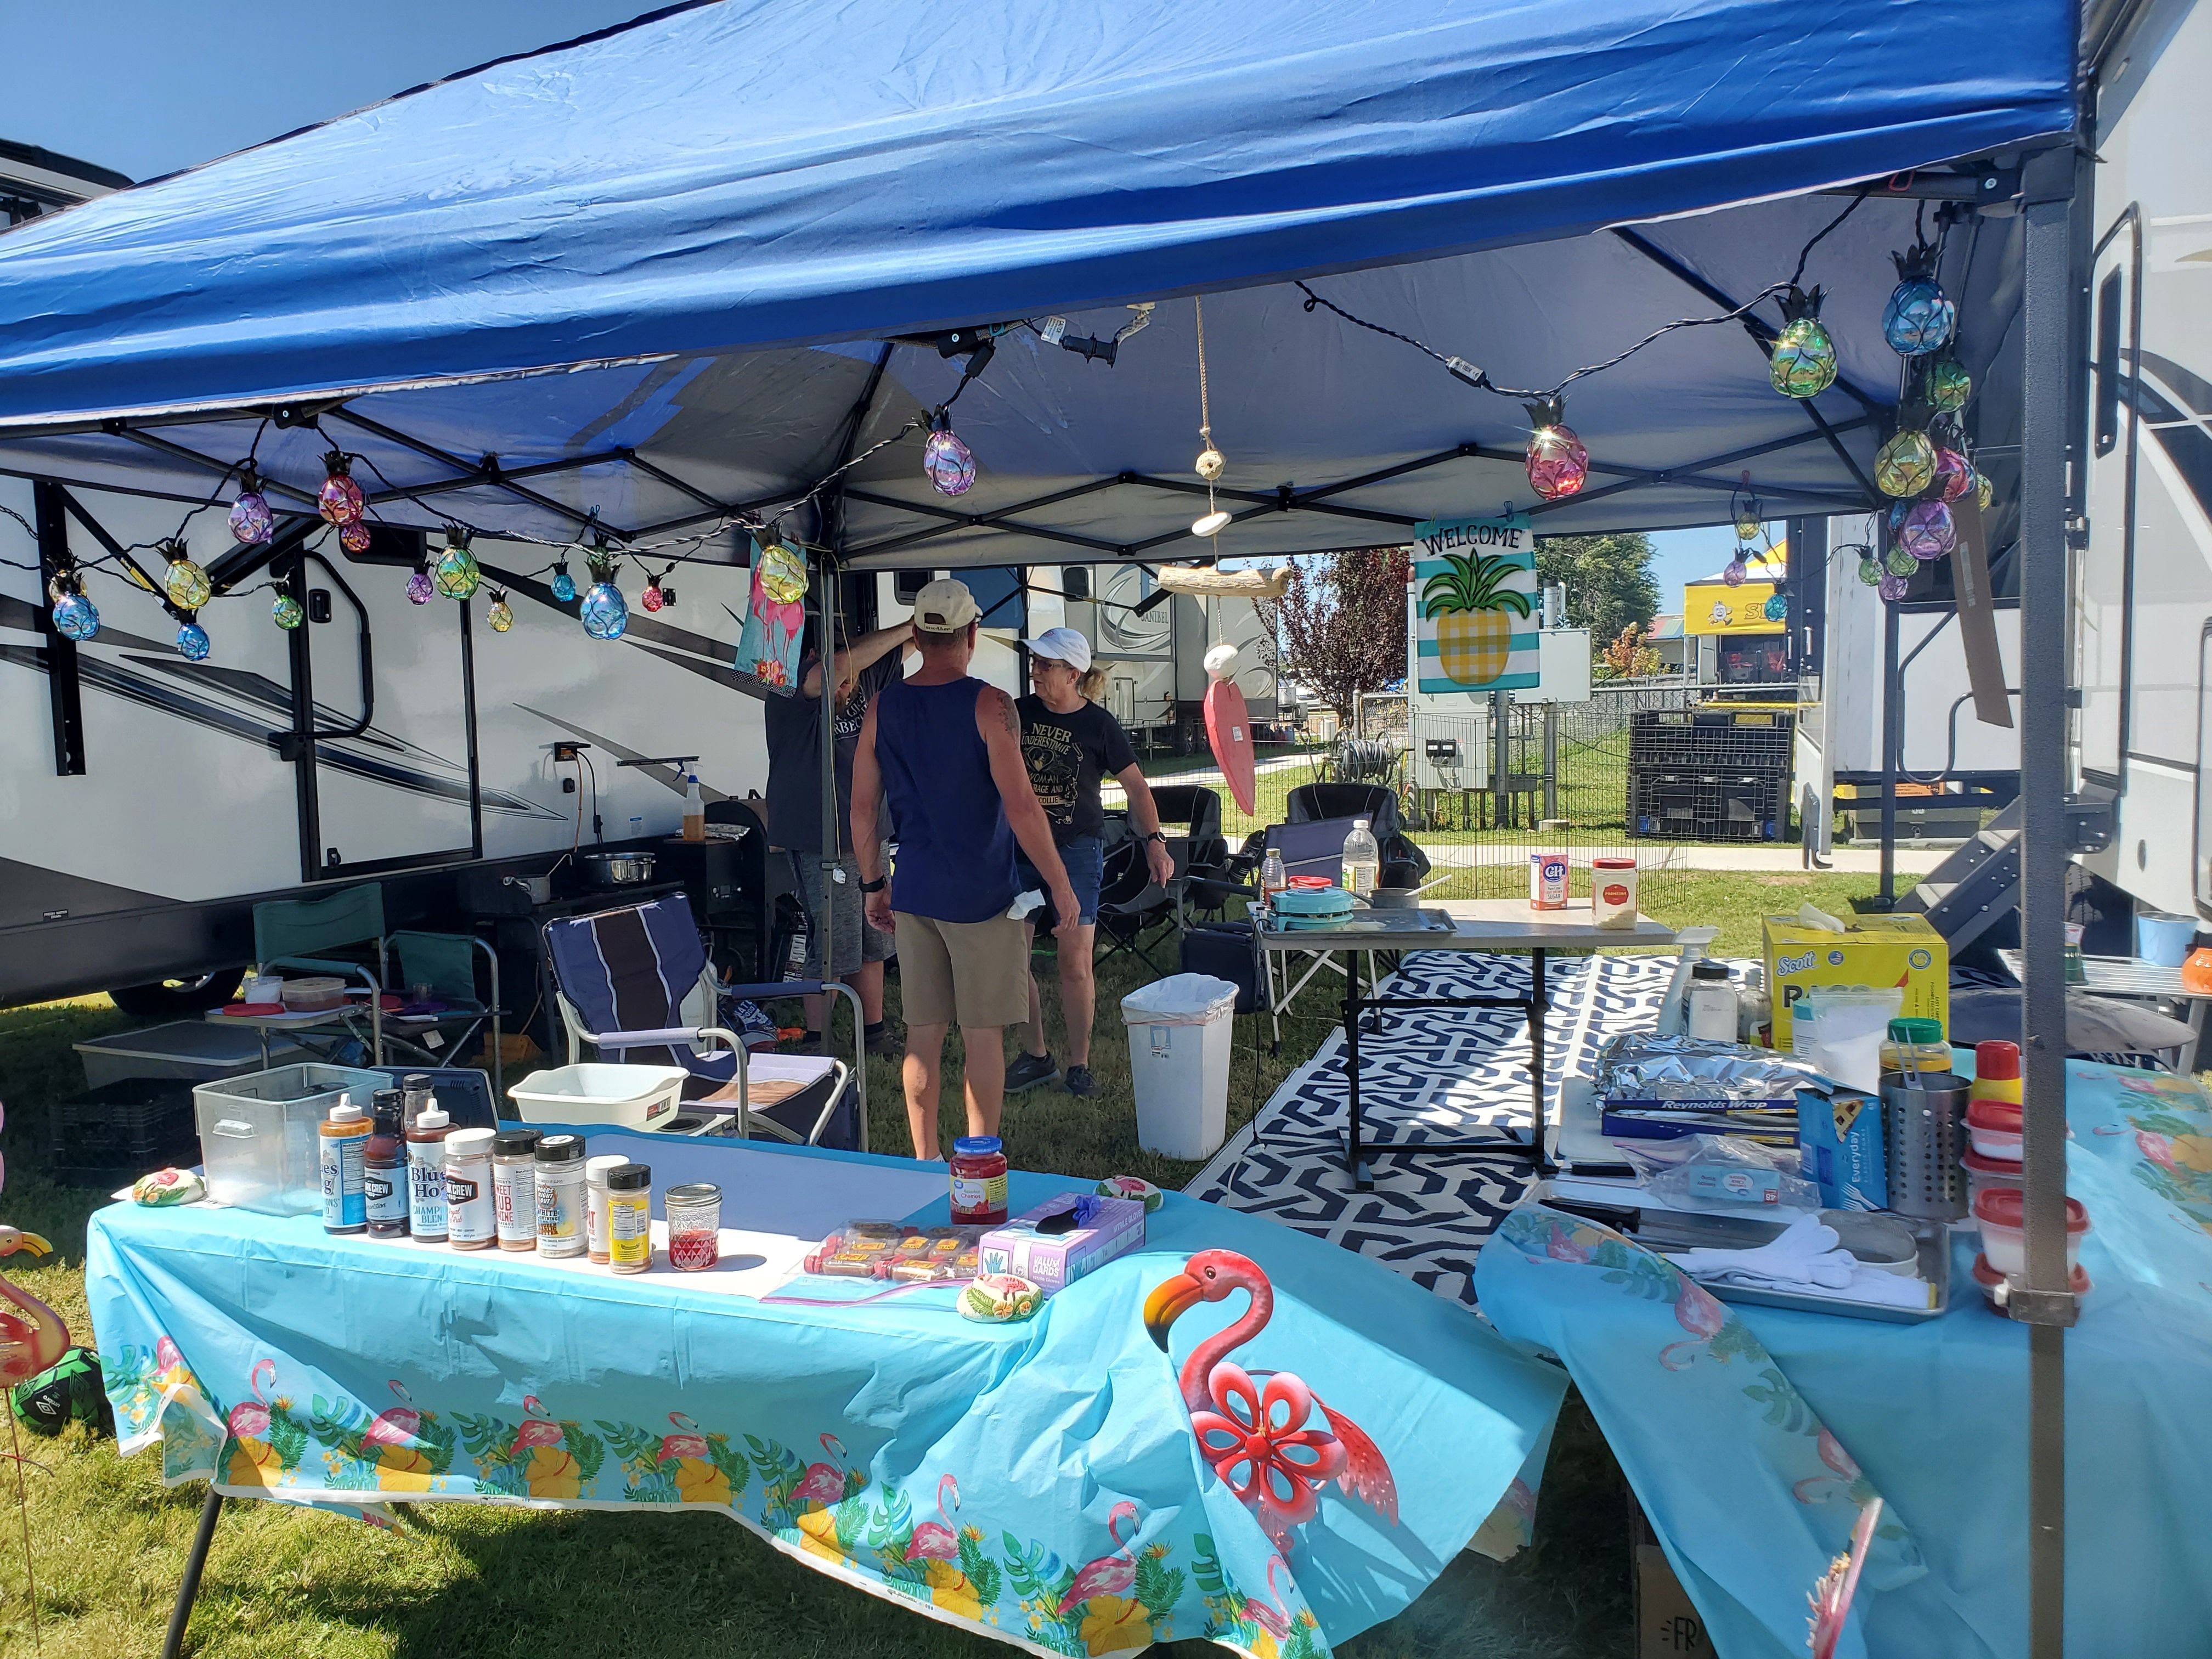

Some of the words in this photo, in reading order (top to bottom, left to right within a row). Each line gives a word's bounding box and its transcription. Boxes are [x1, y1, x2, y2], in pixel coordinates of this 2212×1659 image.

[1420, 524, 1522, 556] WELCOME
[1032, 723, 1072, 742] NEVER
[1022, 736, 1071, 755] UNDERESTIMATE
[1545, 865, 1564, 877] C&H
[1777, 951, 1817, 977] Scott
[1662, 1101, 1726, 1109] Reynolds
[1729, 1101, 1768, 1109] Wrap
[1849, 1132, 1860, 1183] Everyday
[411, 1167, 447, 1182] Blue
[371, 1183, 388, 1194] CREW
[452, 1184, 472, 1197] CREW
[421, 1215, 442, 1223] BLEN
[1113, 1221, 1128, 1234] NITRILE
[1128, 1208, 1143, 1223] GLOVES
[1032, 1265, 1060, 1277] GARDS
[43, 1395, 60, 1408] umbro
